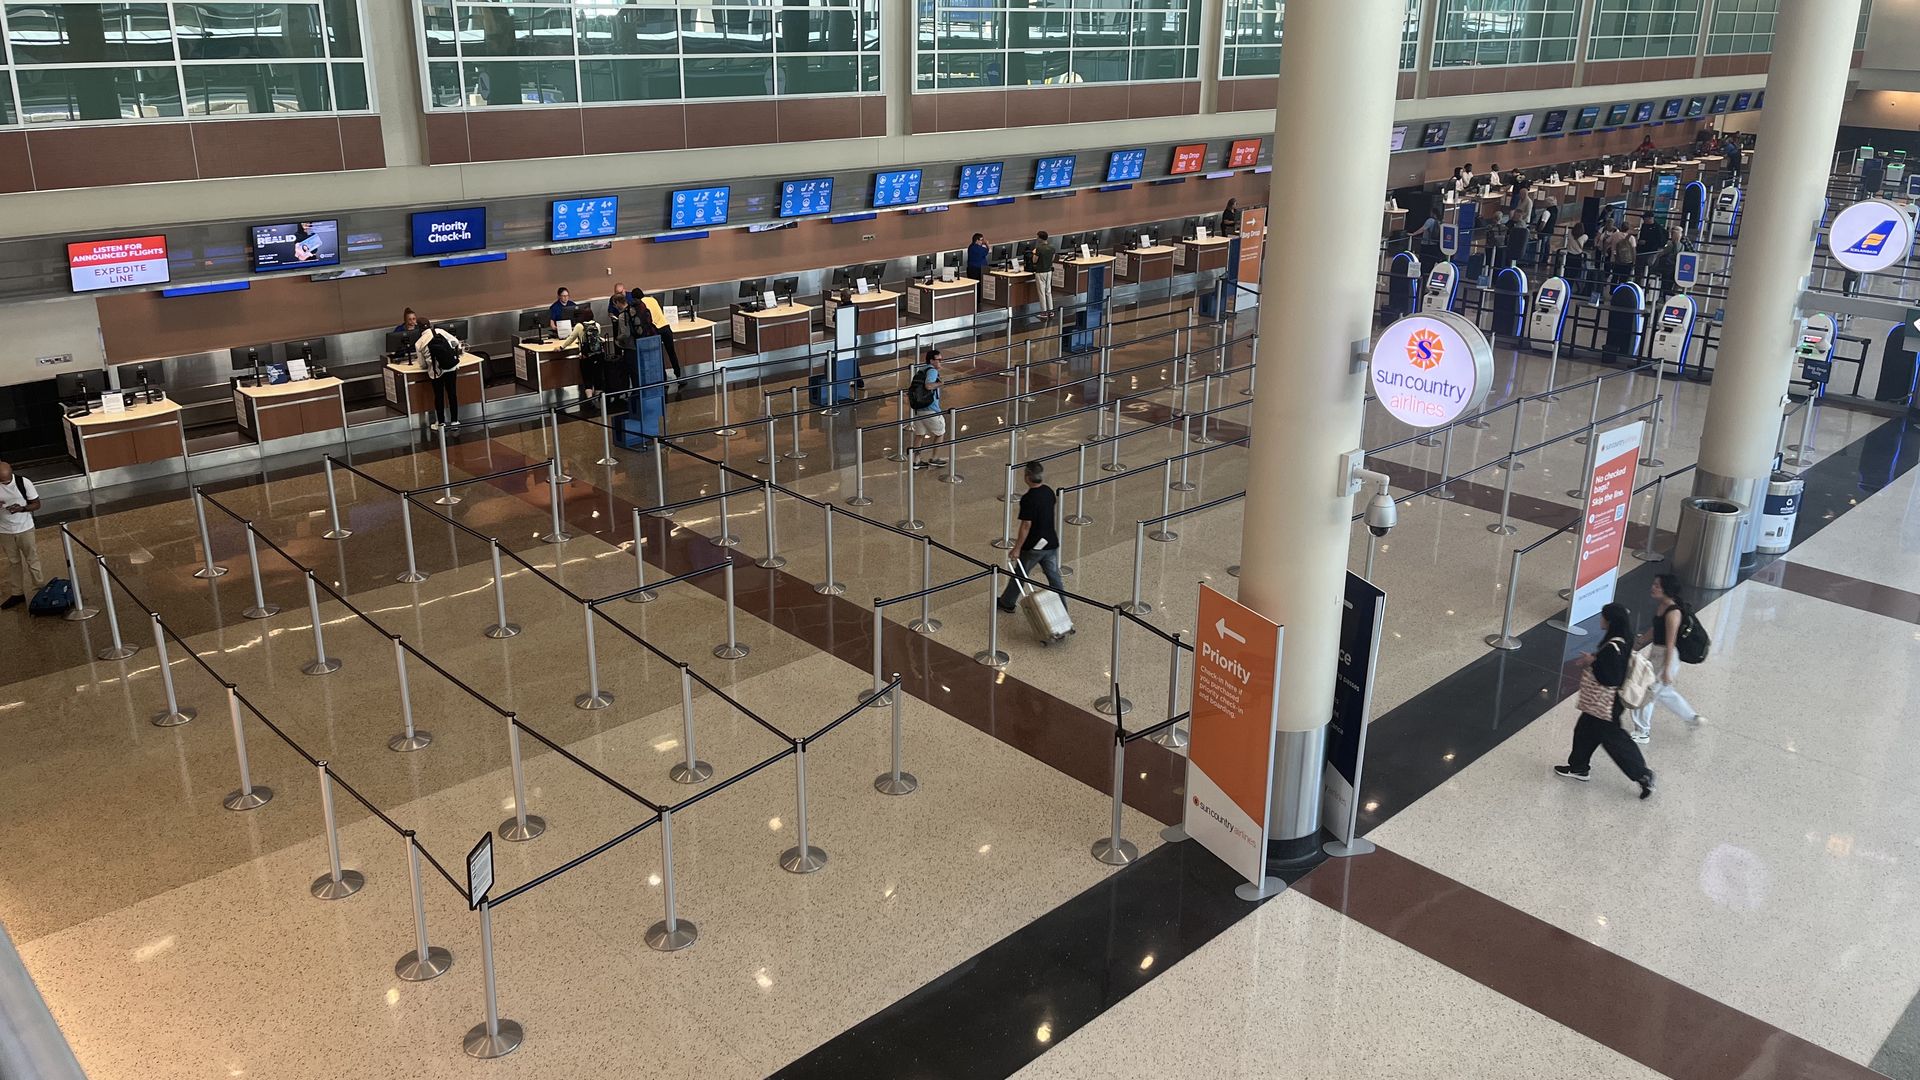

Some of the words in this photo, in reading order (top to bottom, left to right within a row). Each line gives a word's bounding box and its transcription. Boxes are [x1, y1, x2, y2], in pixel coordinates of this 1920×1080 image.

[431, 221, 468, 232] Priority
[257, 235, 286, 245] REAL
[286, 234, 297, 242] ID
[428, 230, 471, 243] Check-in
[72, 251, 127, 262] ANNOUNCED
[129, 248, 164, 257] FLIGHTS
[93, 245, 123, 254] LISTEN
[125, 243, 142, 252] FOR
[94, 264, 147, 276] EXPEDITE
[110, 274, 134, 283] LINE
[1376, 369, 1403, 386] sun
[1405, 376, 1466, 404] country
[1390, 393, 1445, 418] airlines
[1595, 475, 1604, 484] No
[1604, 465, 1627, 481] checked
[1593, 481, 1610, 494] bags?
[1591, 497, 1604, 507] Skip
[1604, 493, 1613, 502] the
[1202, 641, 1251, 685] Priority
[1200, 665, 1224, 684] Check-in
[1224, 680, 1238, 693] here
[1200, 674, 1210, 684] you
[1210, 681, 1240, 703] purchased
[1199, 682, 1219, 699] priority
[1220, 696, 1244, 715] check-in
[1199, 691, 1209, 701] and
[1210, 697, 1236, 719] boarding.
